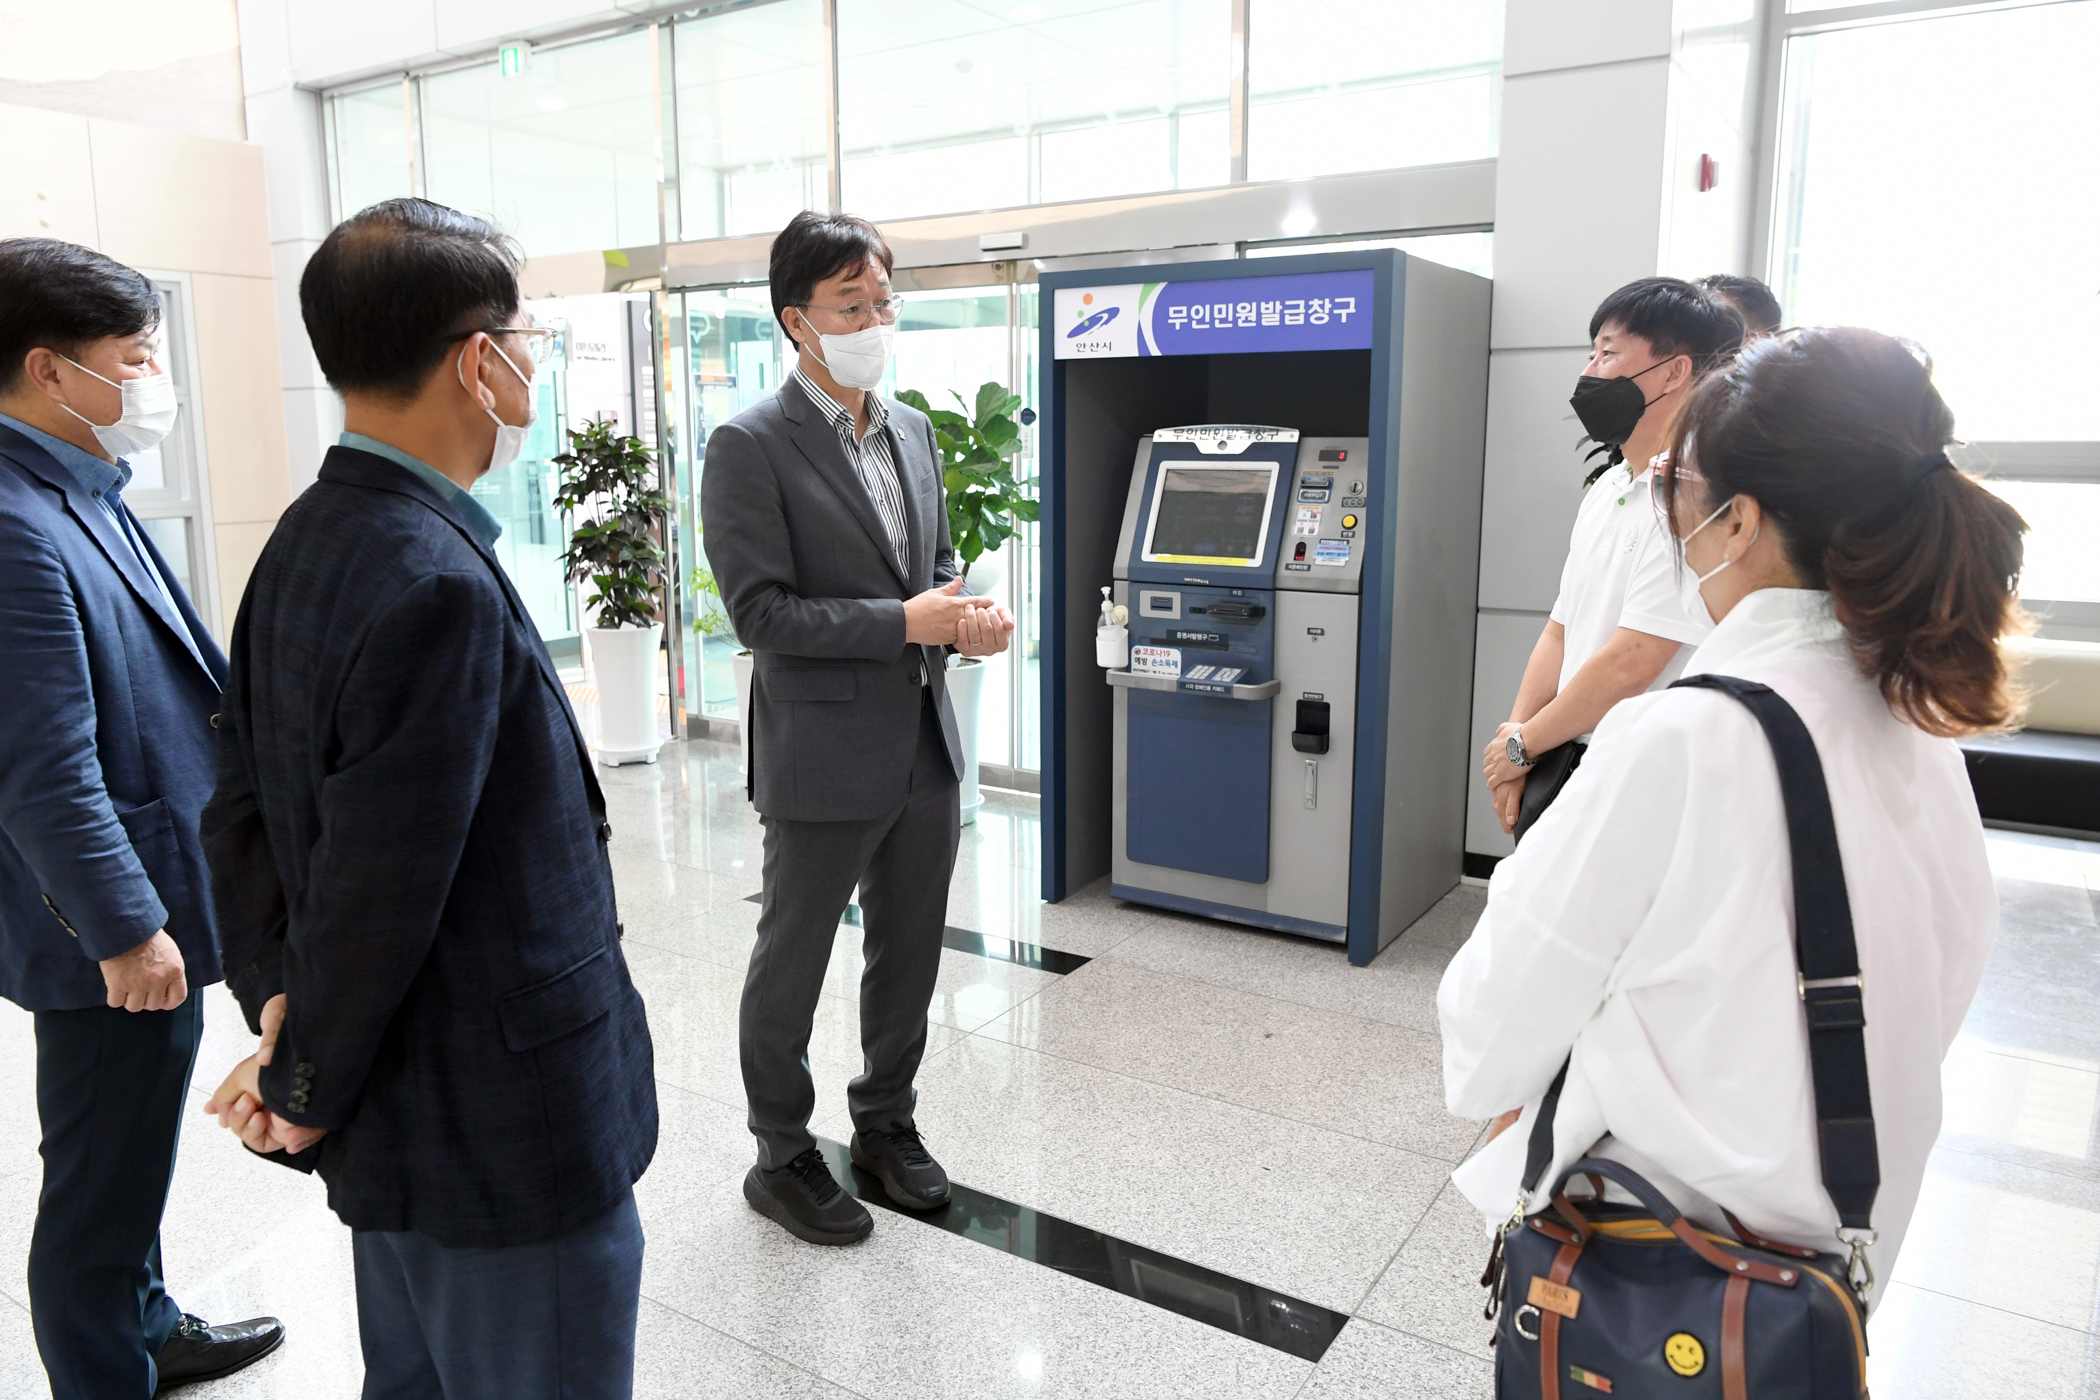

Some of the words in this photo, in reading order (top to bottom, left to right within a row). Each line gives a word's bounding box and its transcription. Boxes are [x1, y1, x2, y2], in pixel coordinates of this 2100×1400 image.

[1167, 297, 1357, 331] 무인민원발급창구
[1075, 341, 1112, 353] 안산시
[1173, 428, 1280, 441] 무인민원발급창구
[1338, 452, 1346, 460] 0
[1142, 648, 1171, 657] 코로나19
[1134, 656, 1148, 666] 예방
[1151, 658, 1179, 669] 손소독제
